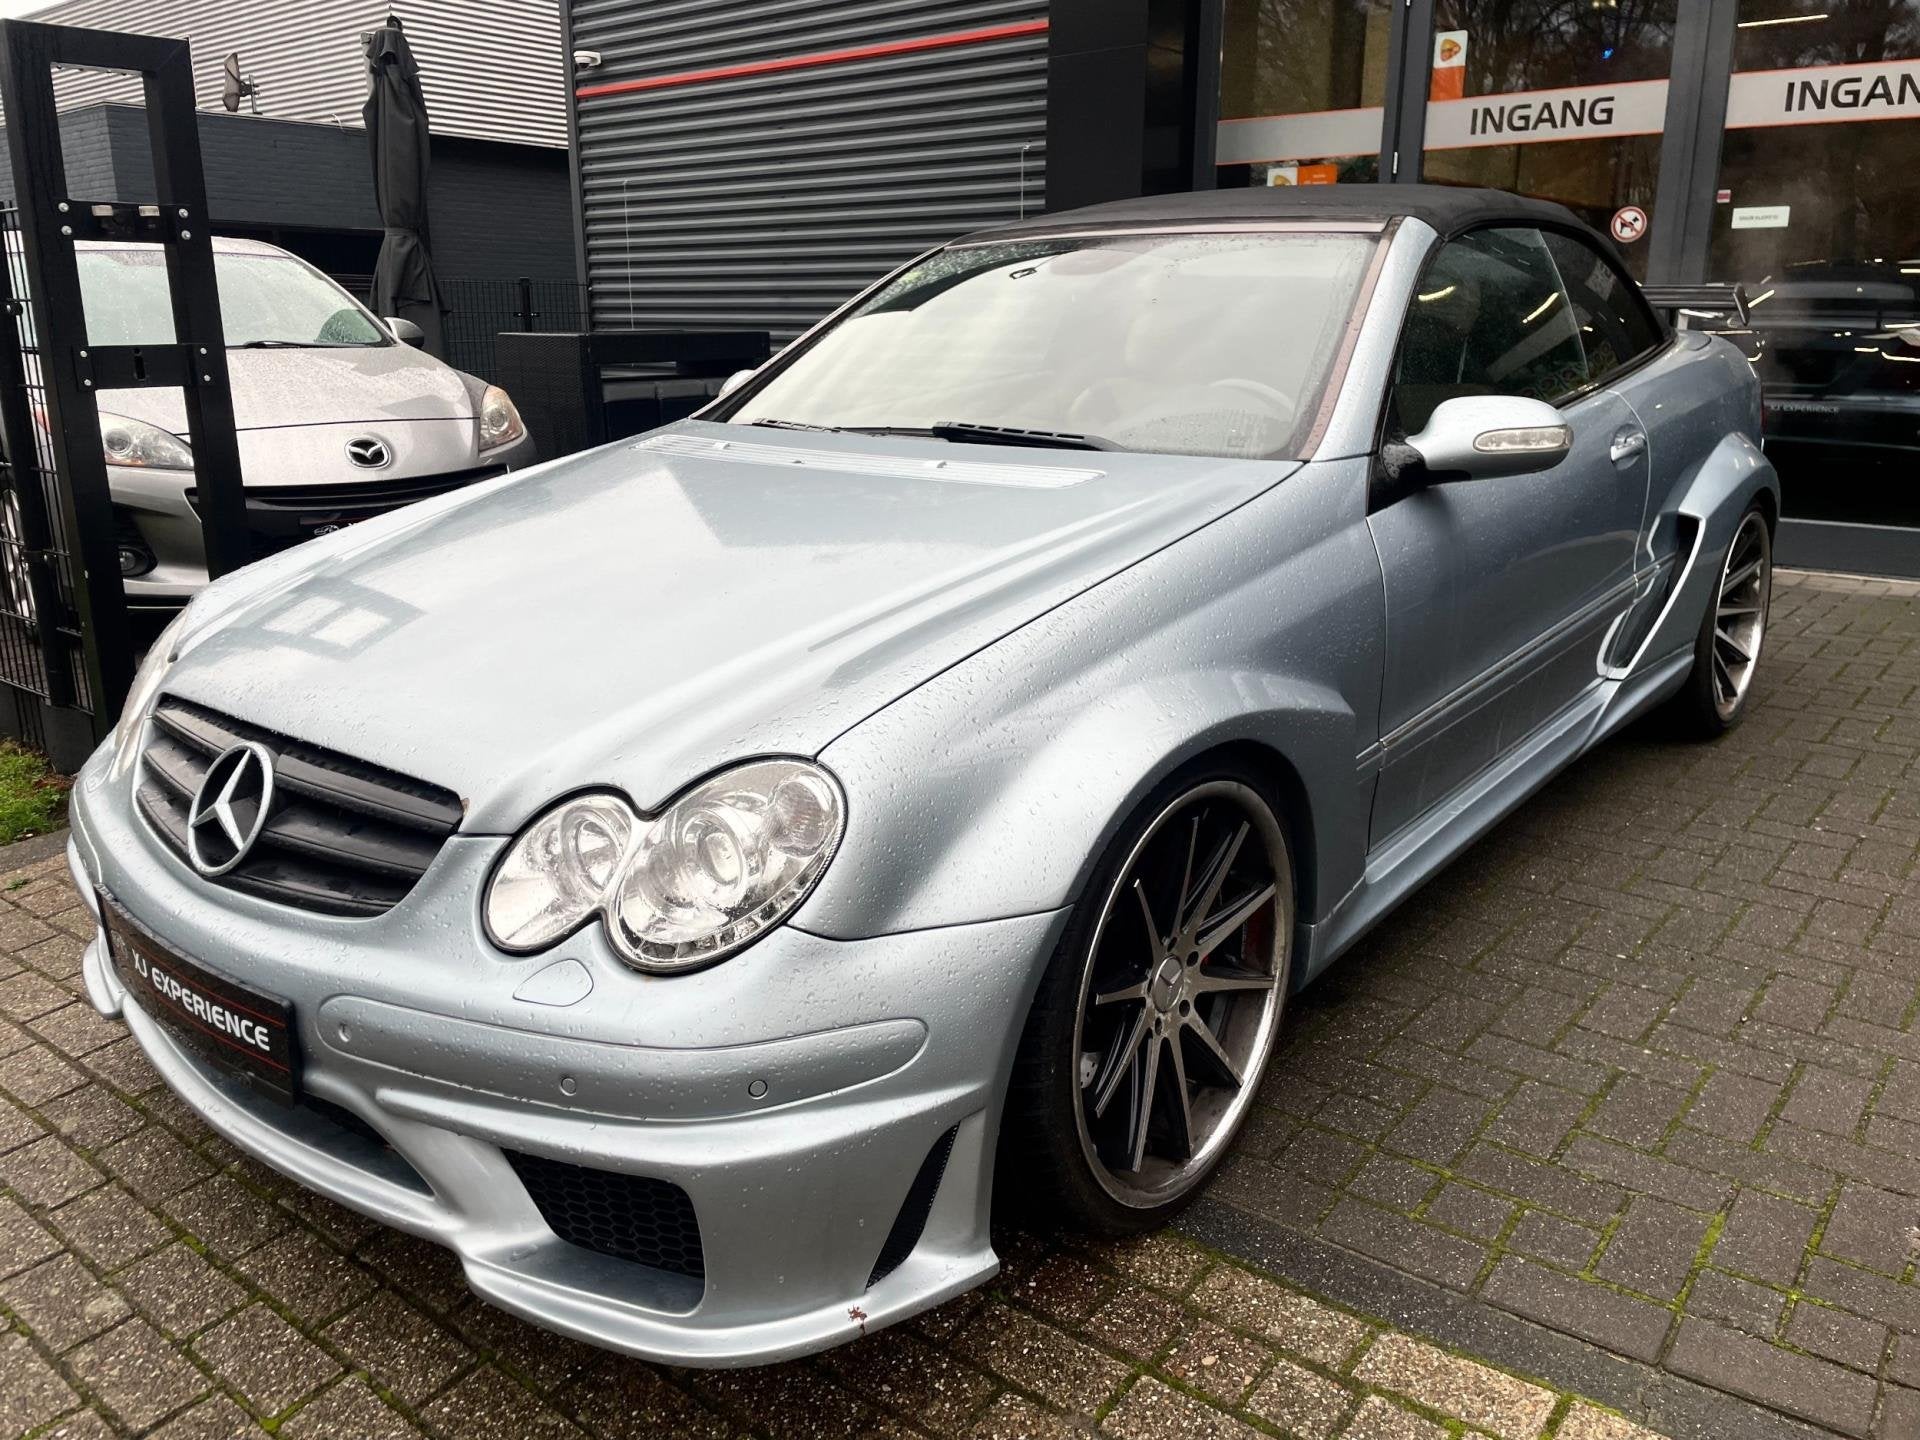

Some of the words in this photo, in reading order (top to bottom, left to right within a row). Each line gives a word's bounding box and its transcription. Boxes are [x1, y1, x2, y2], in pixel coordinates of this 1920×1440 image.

[1470, 96, 1615, 135] INGANG
[132, 948, 148, 979] XJ
[152, 967, 270, 1051] EXPERIENCE
